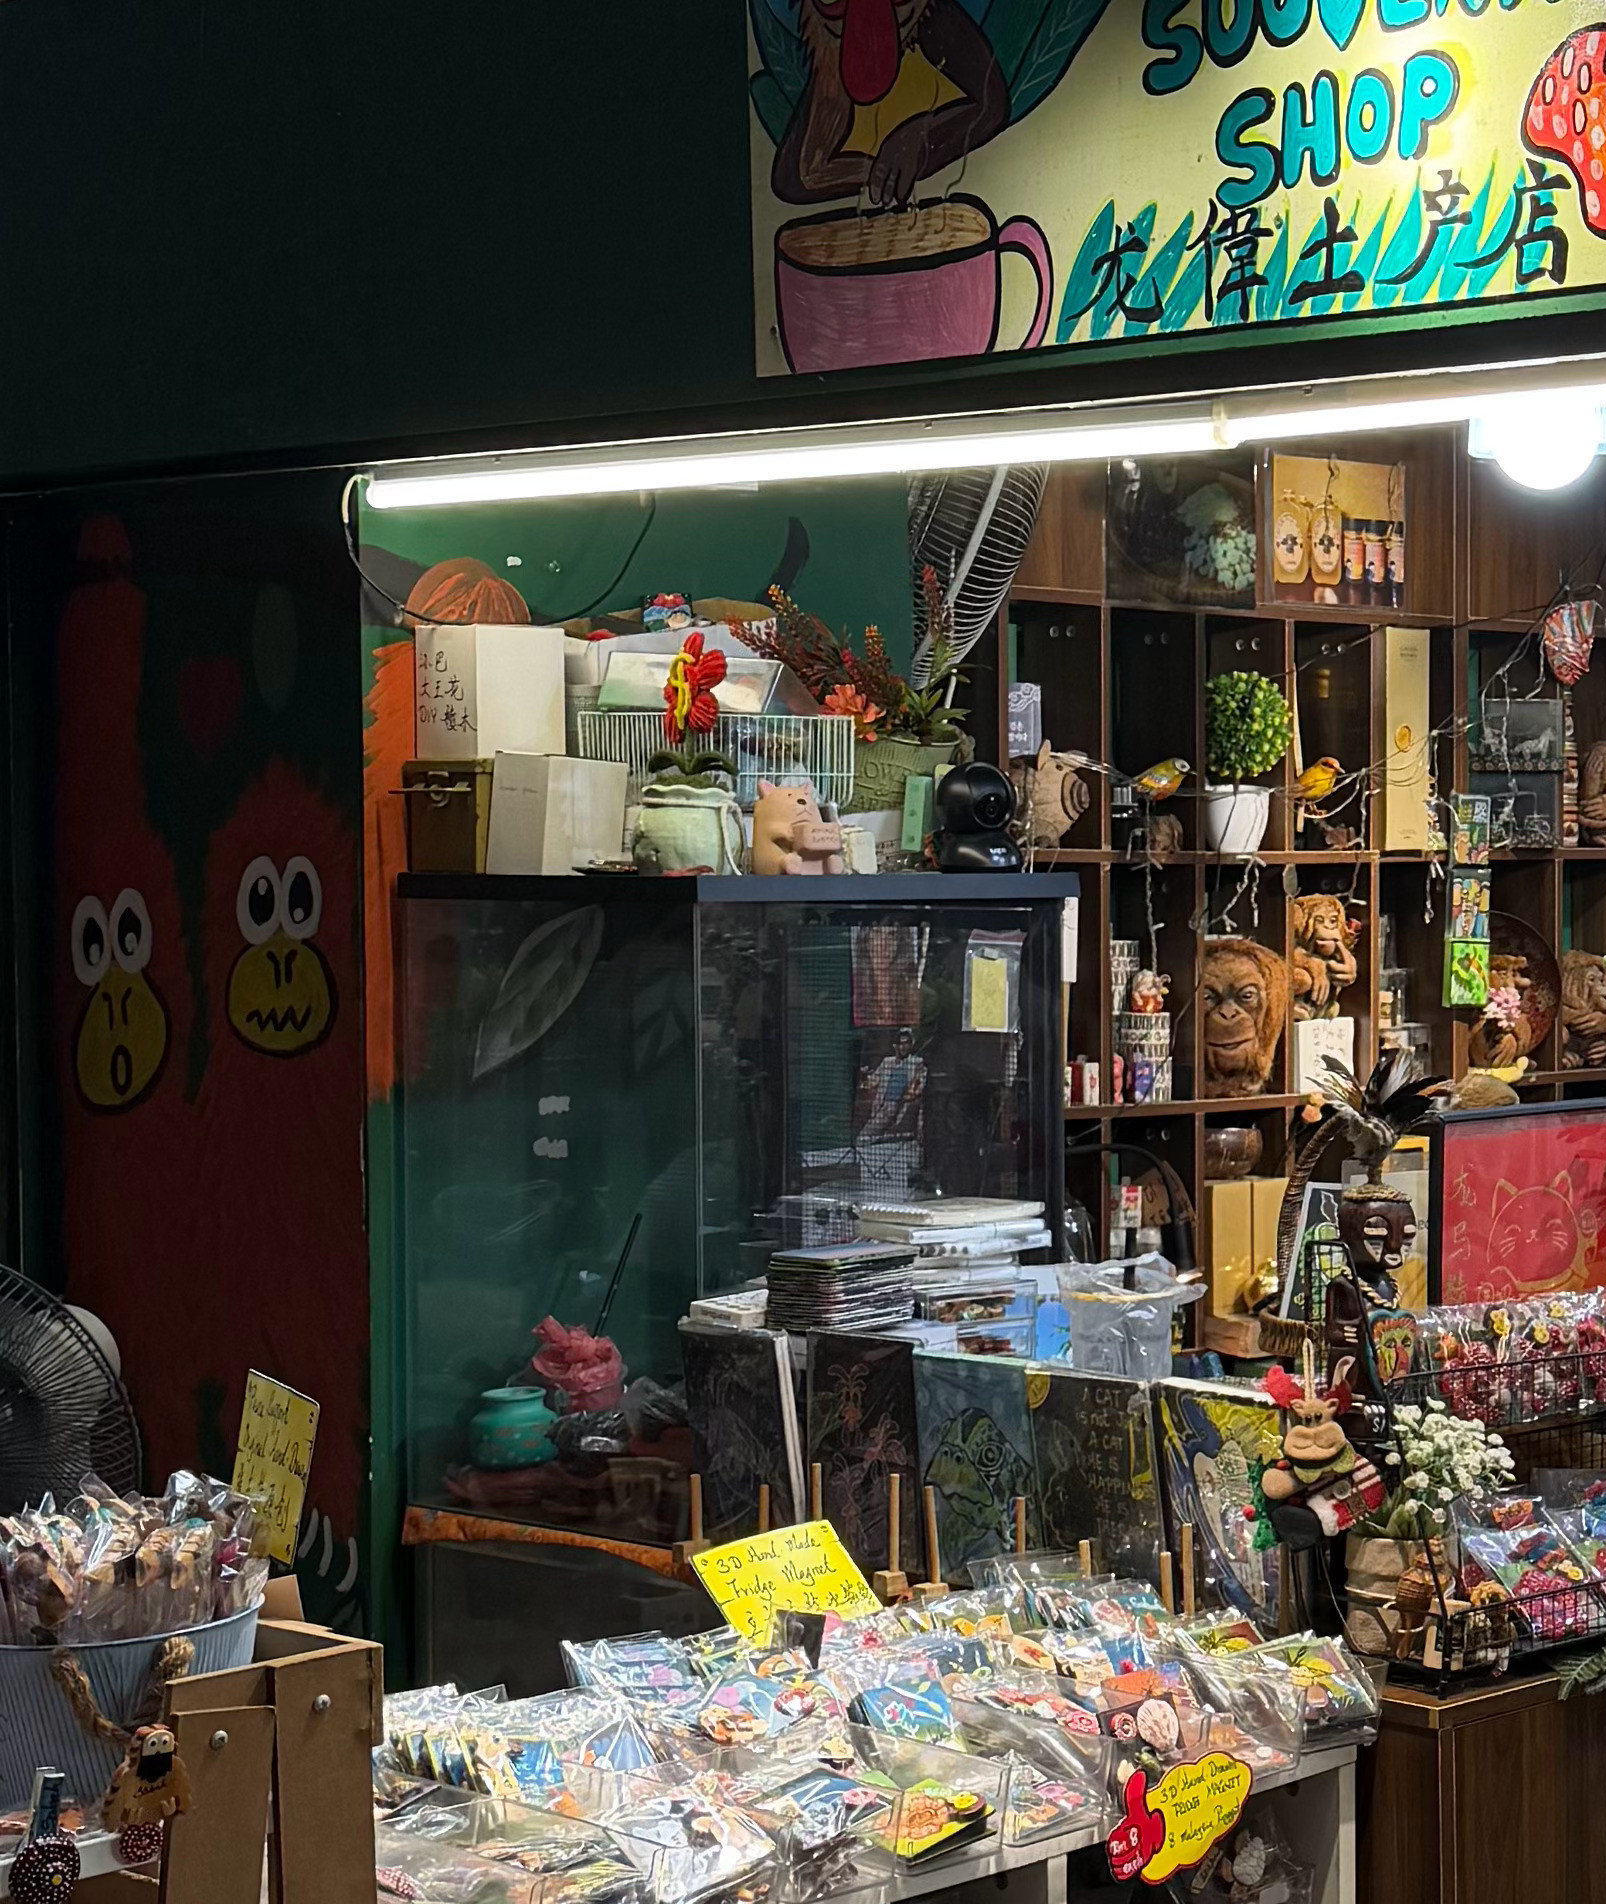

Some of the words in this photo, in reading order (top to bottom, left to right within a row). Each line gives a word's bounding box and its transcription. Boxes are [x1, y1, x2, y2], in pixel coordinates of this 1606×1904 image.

[1216, 49, 1458, 210] SHOP
[725, 1578, 777, 1602] Fridge
[782, 1553, 837, 1587] Magnet
